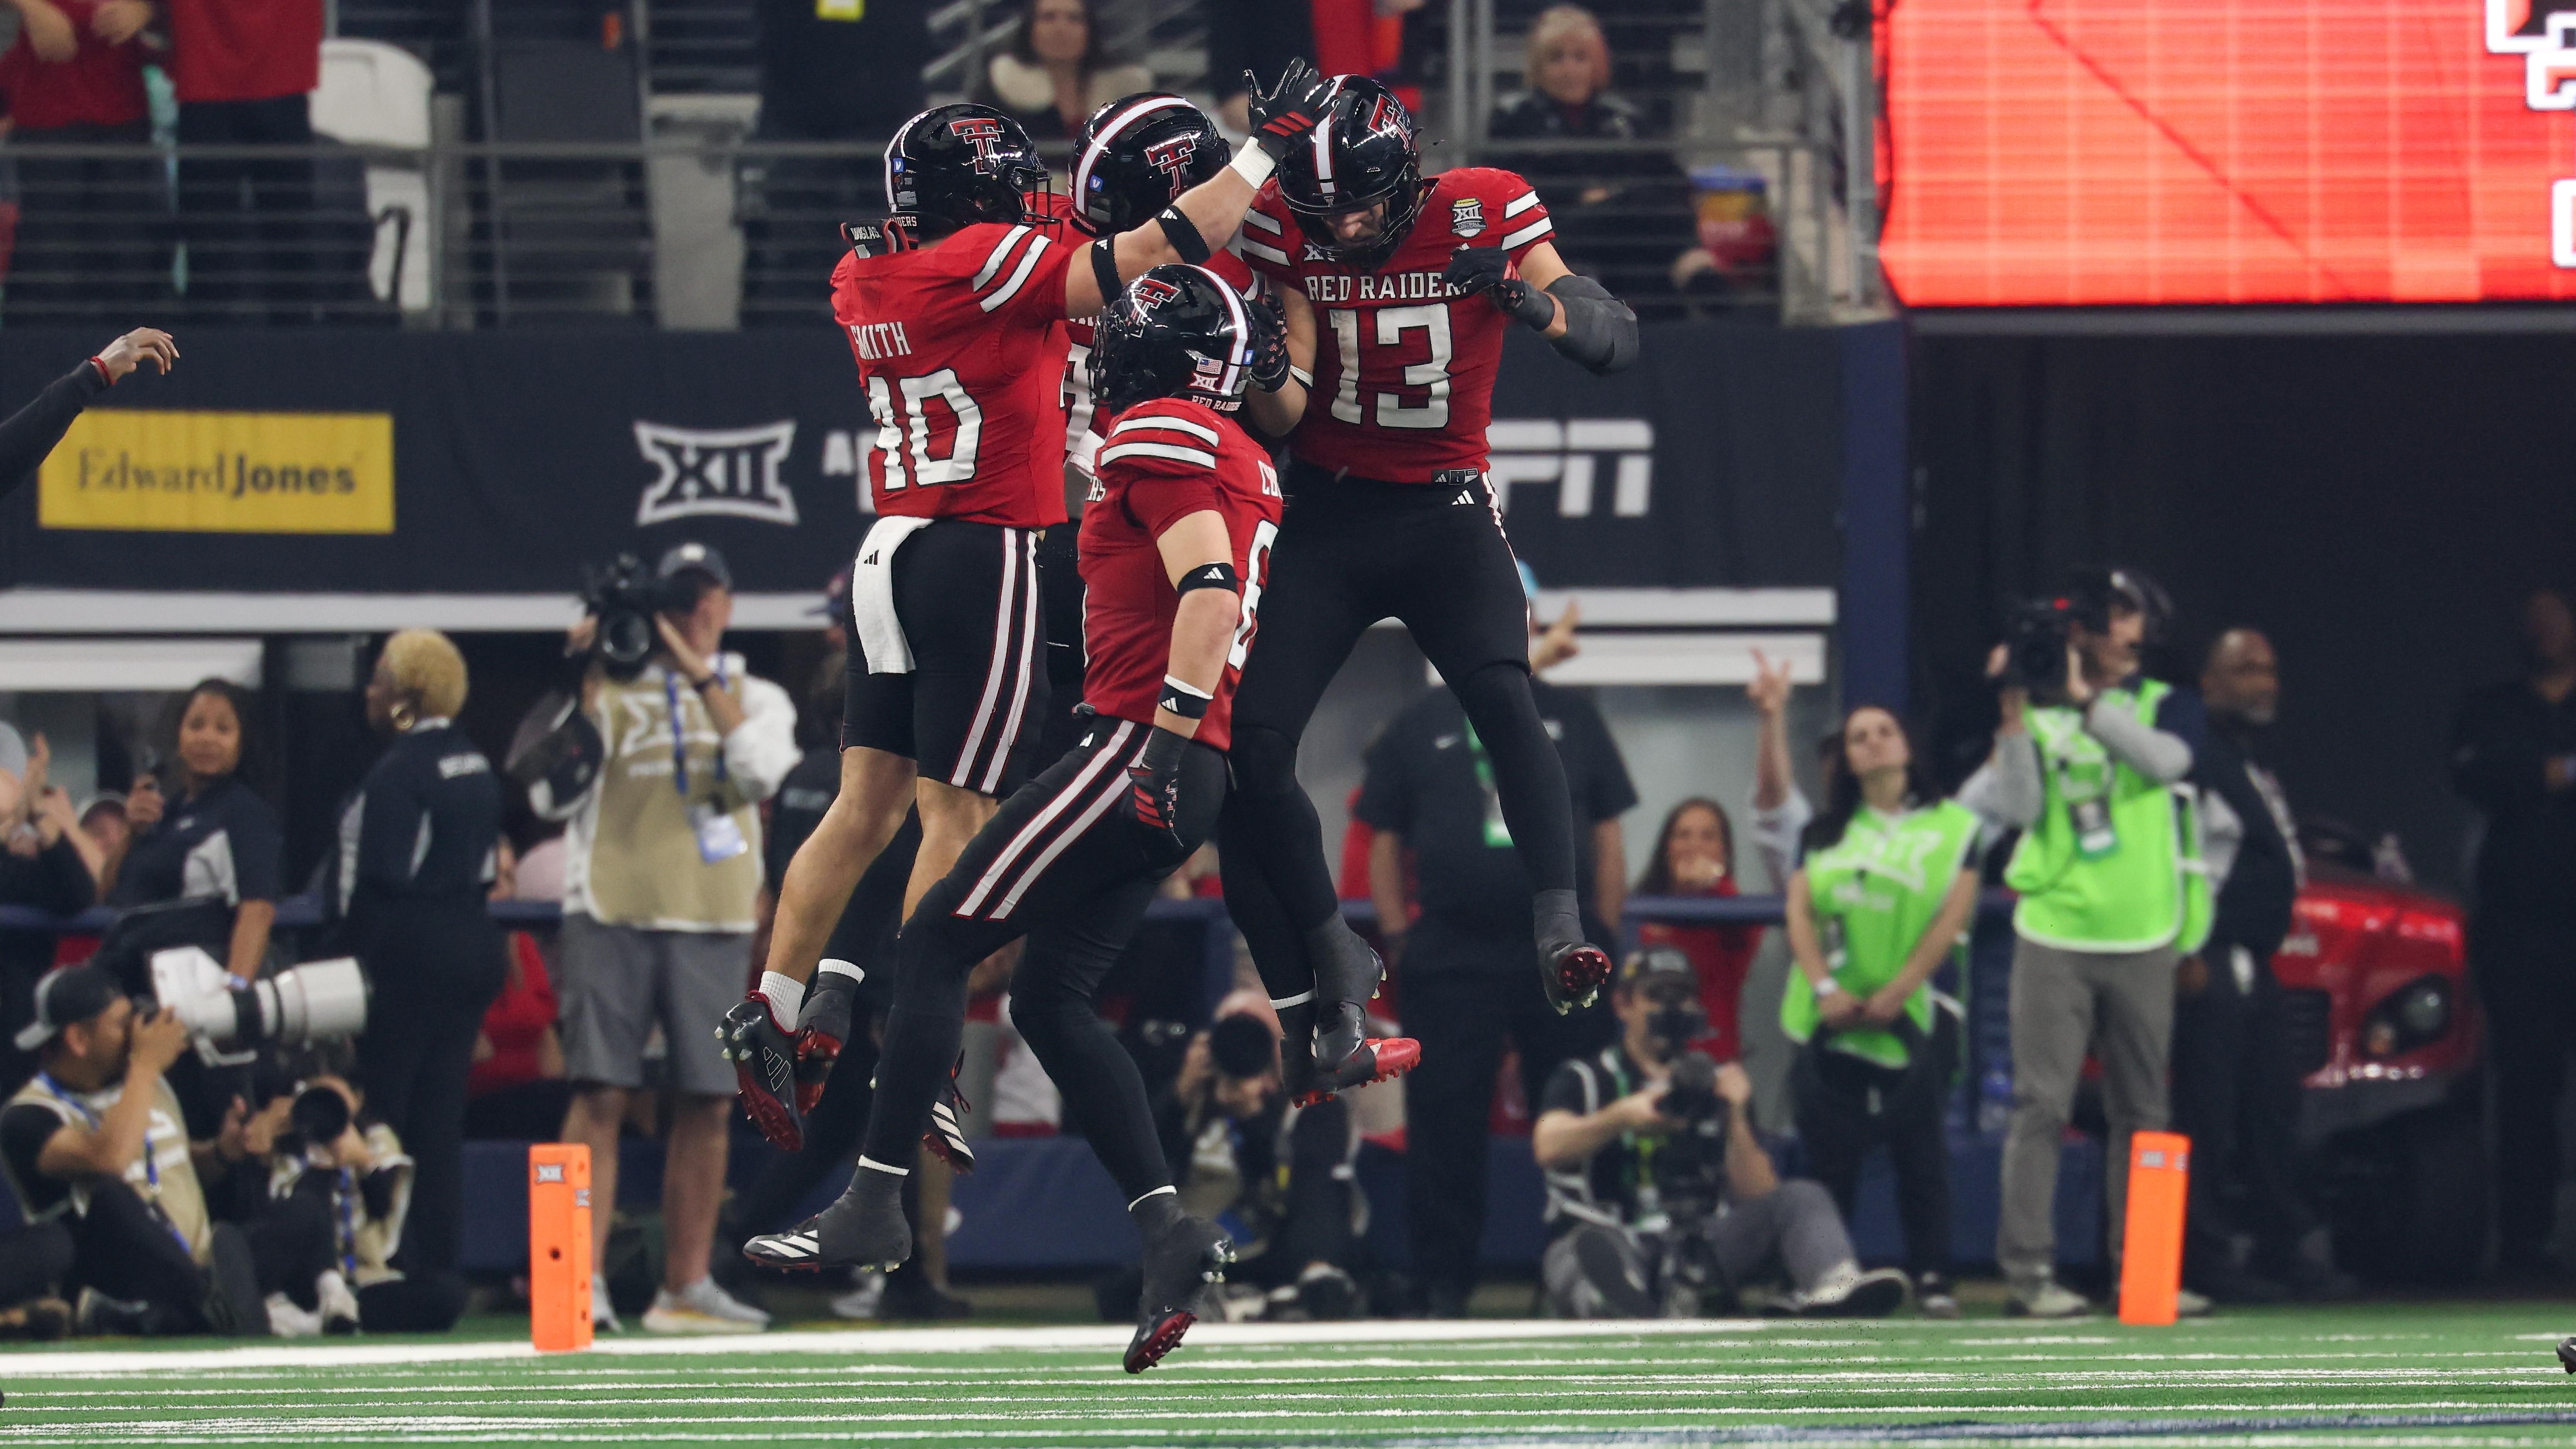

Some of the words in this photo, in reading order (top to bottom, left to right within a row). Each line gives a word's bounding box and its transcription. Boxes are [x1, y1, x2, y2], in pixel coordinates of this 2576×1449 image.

[1304, 276, 1351, 301] RED
[850, 321, 911, 360] SMITH
[1329, 302, 1452, 428] 13
